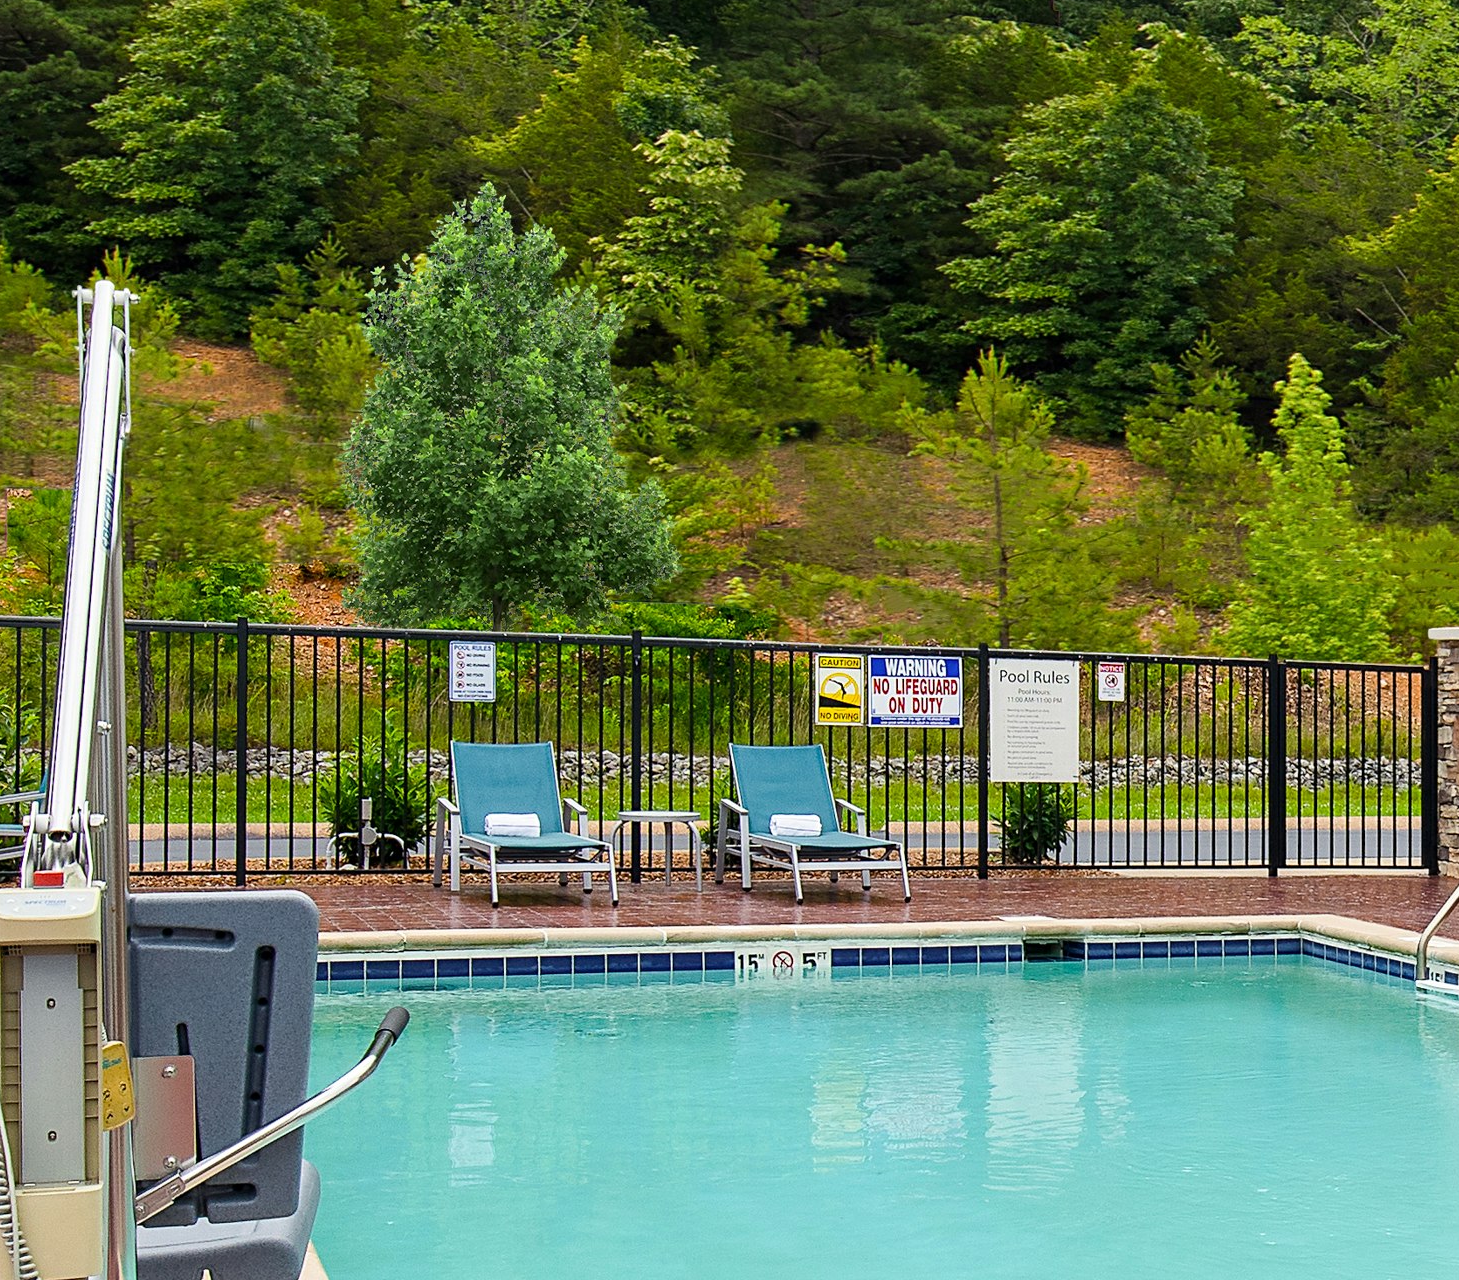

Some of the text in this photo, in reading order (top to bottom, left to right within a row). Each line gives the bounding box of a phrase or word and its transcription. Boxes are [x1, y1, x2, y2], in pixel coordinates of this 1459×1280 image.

[821, 659, 859, 667] CAUTION
[885, 658, 947, 677] WARNING
[1000, 669, 1070, 684] Pool Rules
[873, 678, 958, 695] NO LIFEGUARD
[889, 697, 943, 714] ON DUTY
